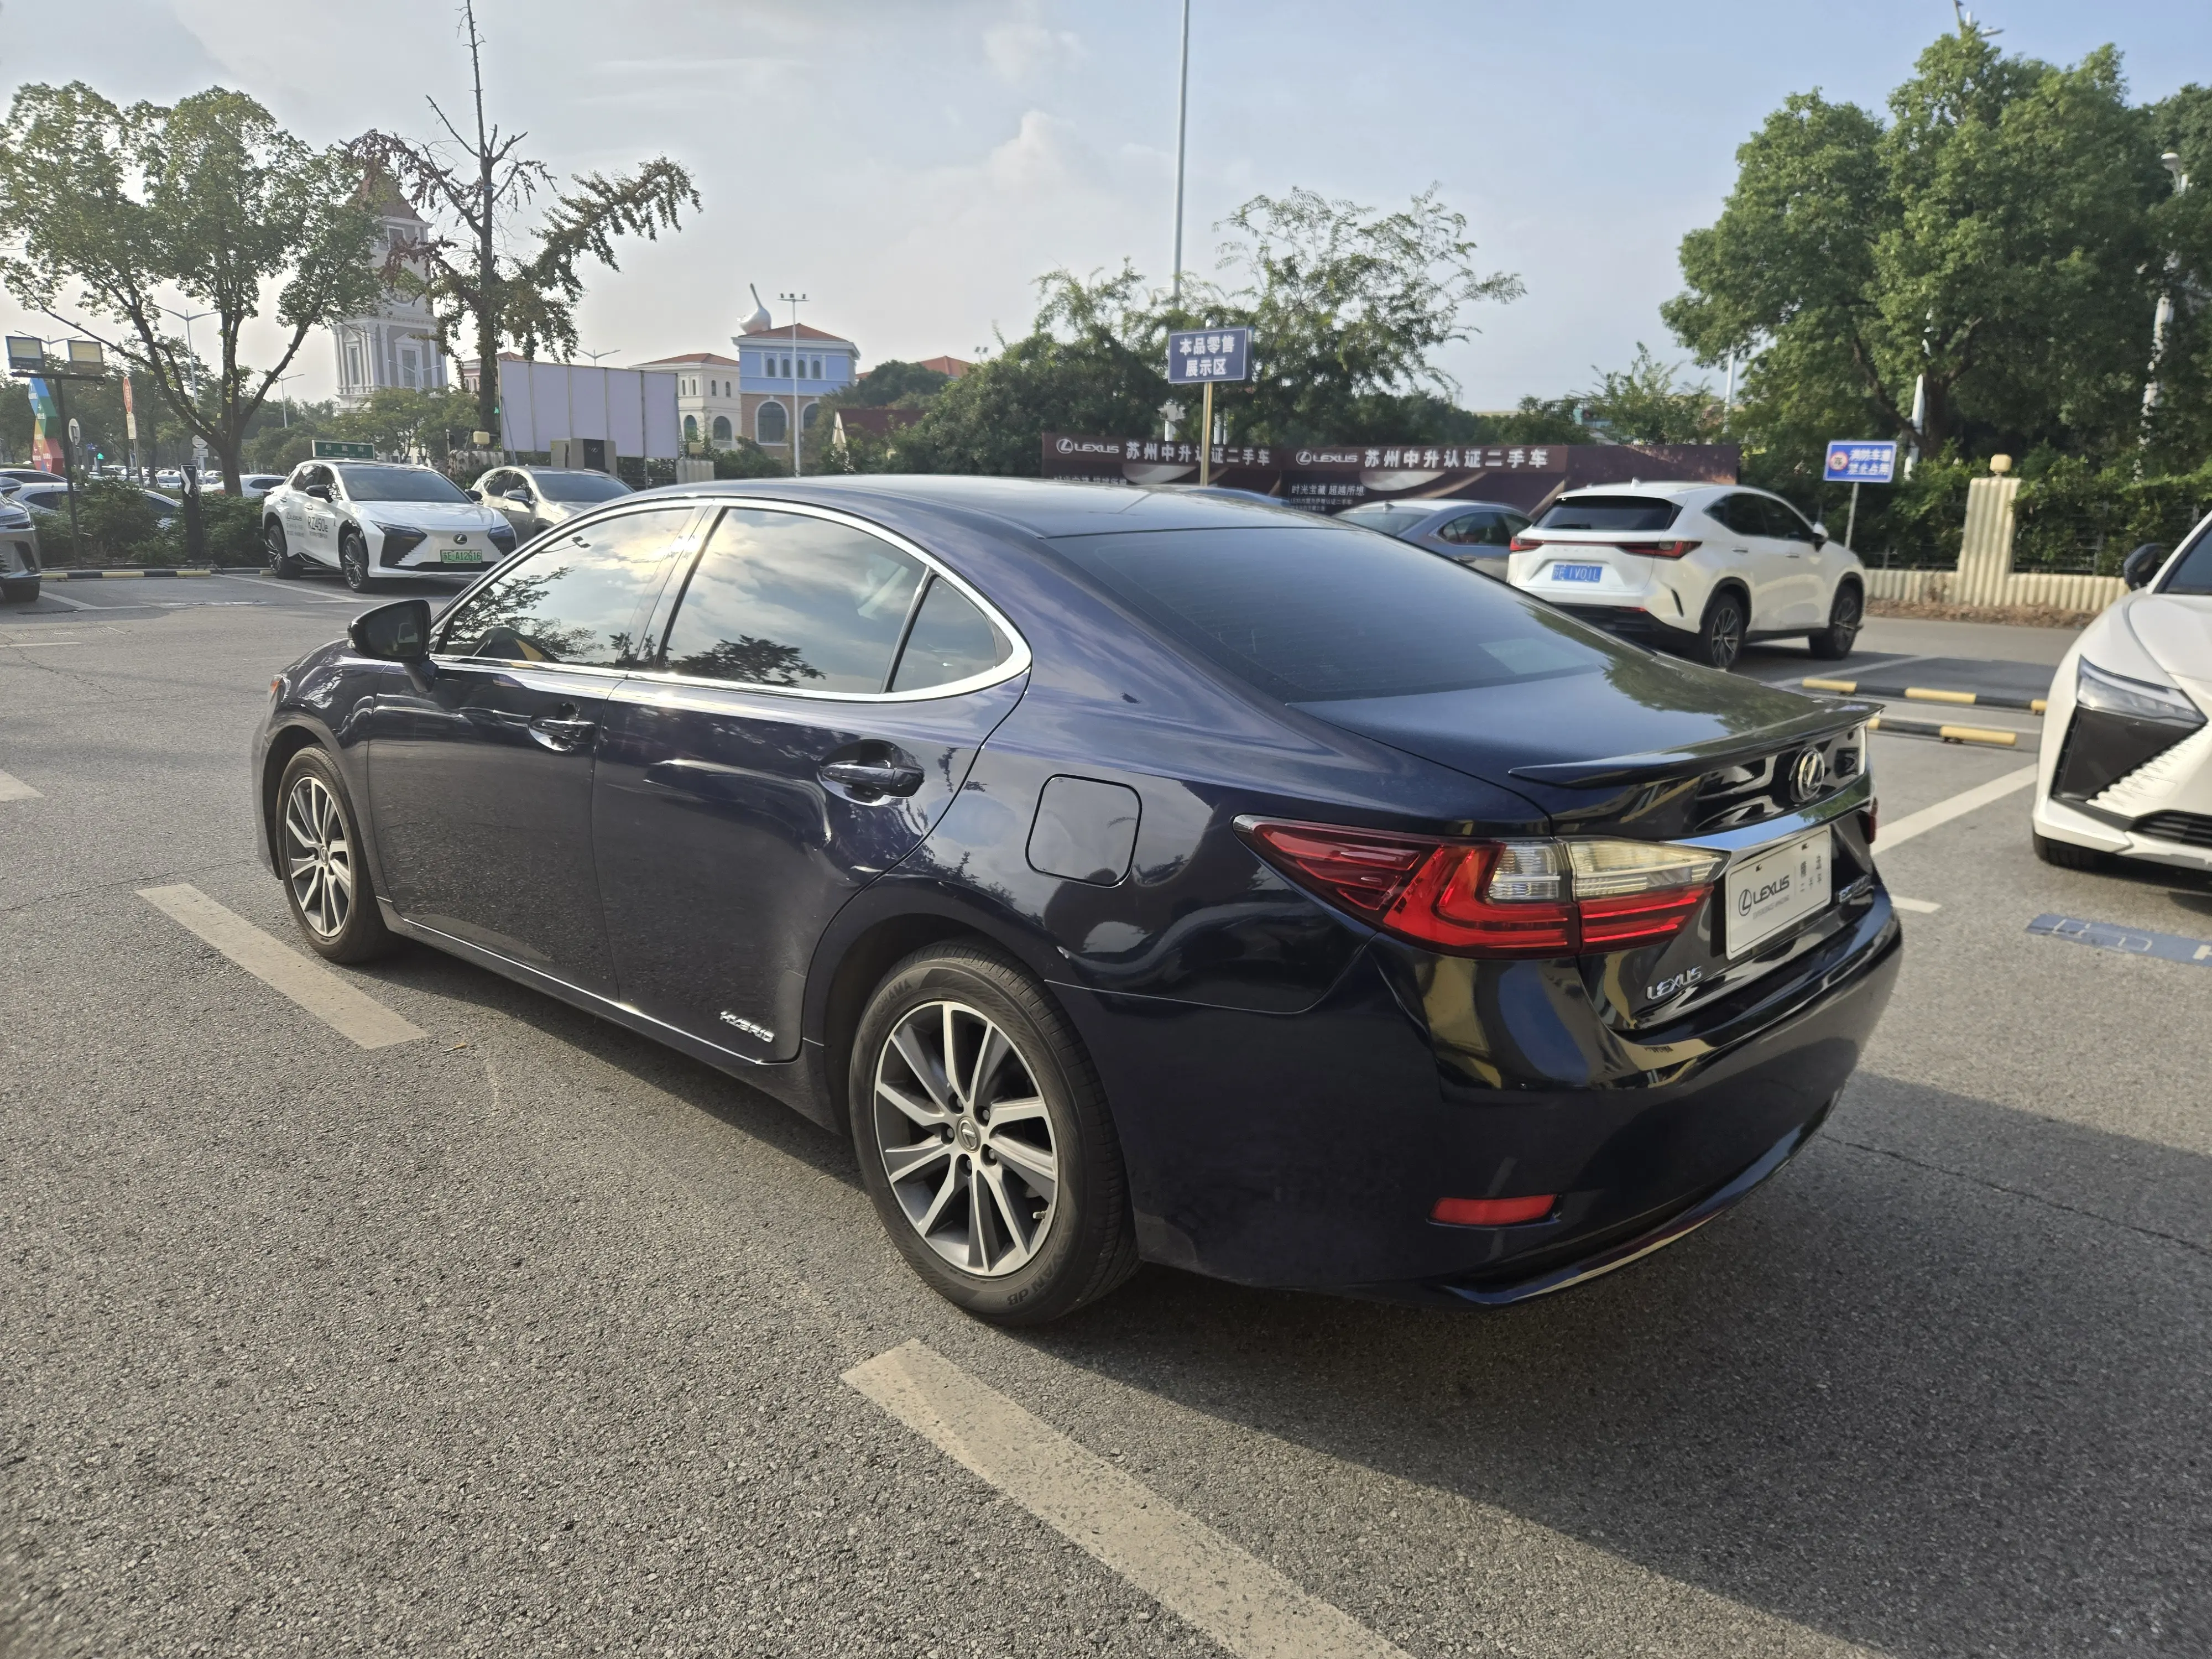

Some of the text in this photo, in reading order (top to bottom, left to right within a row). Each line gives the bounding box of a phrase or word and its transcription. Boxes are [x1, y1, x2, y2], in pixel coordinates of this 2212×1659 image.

[1179, 335, 1235, 356] 本品零售
[1185, 358, 1227, 377] 展示区
[1074, 442, 1120, 454] LEXUS
[1312, 453, 1358, 463] LEXUS
[1364, 448, 1548, 468] 苏州中升认证二手车
[1291, 484, 1365, 497] 时光宝藏 超越所想
[308, 516, 328, 533] RZ450e
[1753, 874, 1790, 905] LEXUS
[1646, 965, 1702, 999] LEXUS
[719, 1011, 774, 1042] HYBRID
